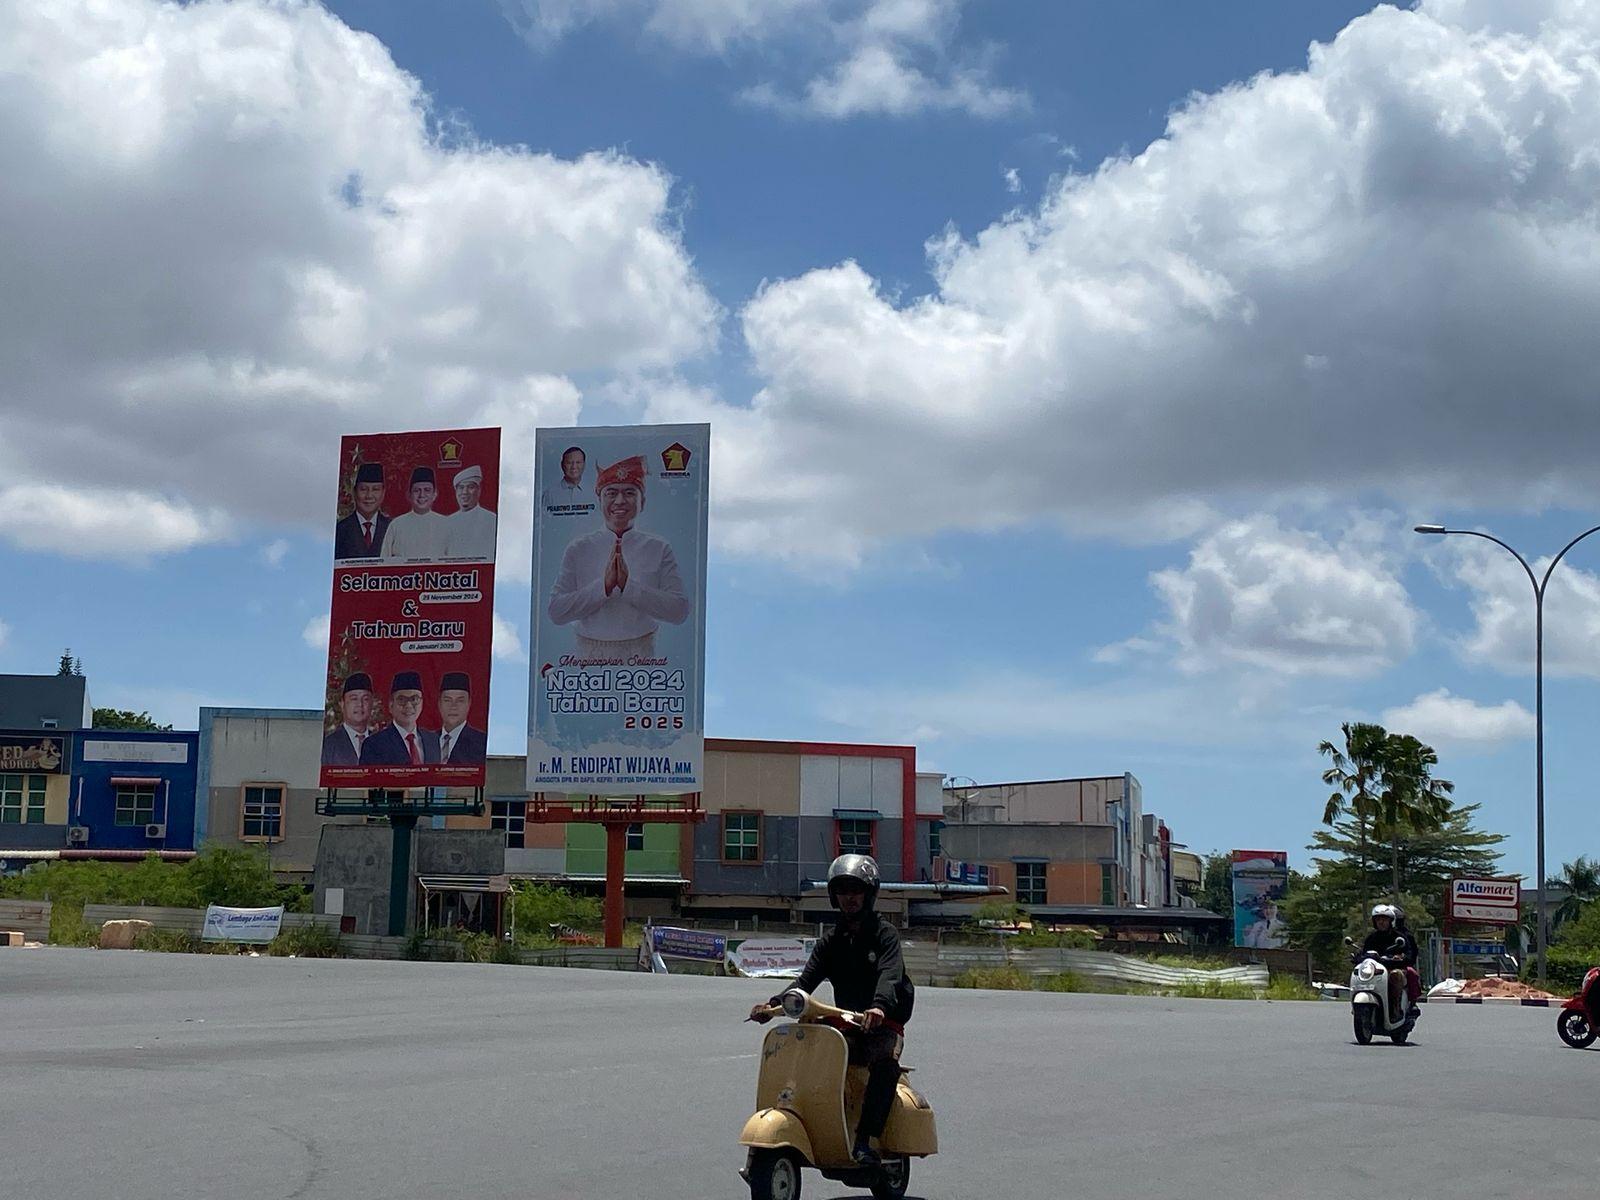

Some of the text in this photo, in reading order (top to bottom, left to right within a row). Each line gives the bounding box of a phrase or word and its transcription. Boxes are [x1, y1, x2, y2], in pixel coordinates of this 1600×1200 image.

[340, 570, 479, 592] Selamat Natal
[402, 599, 420, 618] &
[352, 618, 466, 639] Tahun Baru
[627, 654, 668, 667] Selamat
[546, 669, 685, 691] Natal 2024
[546, 692, 685, 713] Tahun Baru
[625, 716, 684, 729] 2025
[0, 745, 23, 760] ED
[539, 761, 549, 774] Ir.
[551, 757, 567, 774] M.
[571, 757, 622, 774] ENDIPAT
[1457, 882, 1515, 895] Alfamart
